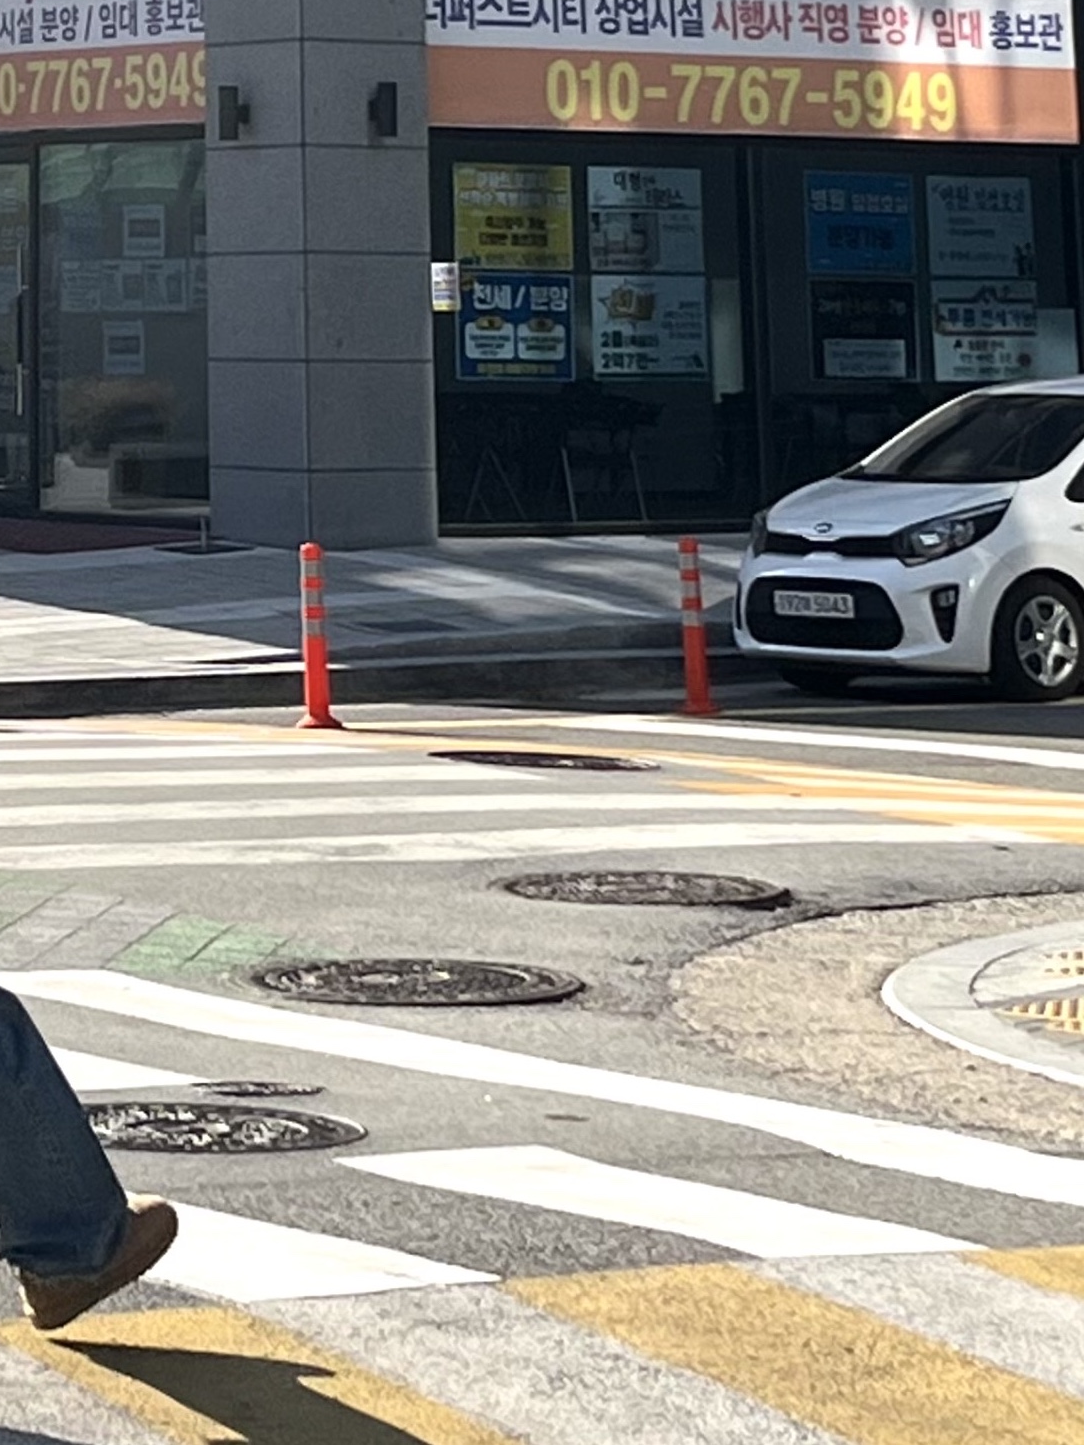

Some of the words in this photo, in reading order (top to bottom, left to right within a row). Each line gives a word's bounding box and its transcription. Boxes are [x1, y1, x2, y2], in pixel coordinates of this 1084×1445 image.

[797, 1, 850, 45] 직영
[988, 10, 1064, 52] 홍보관
[545, 58, 957, 133] 010-7767-5949
